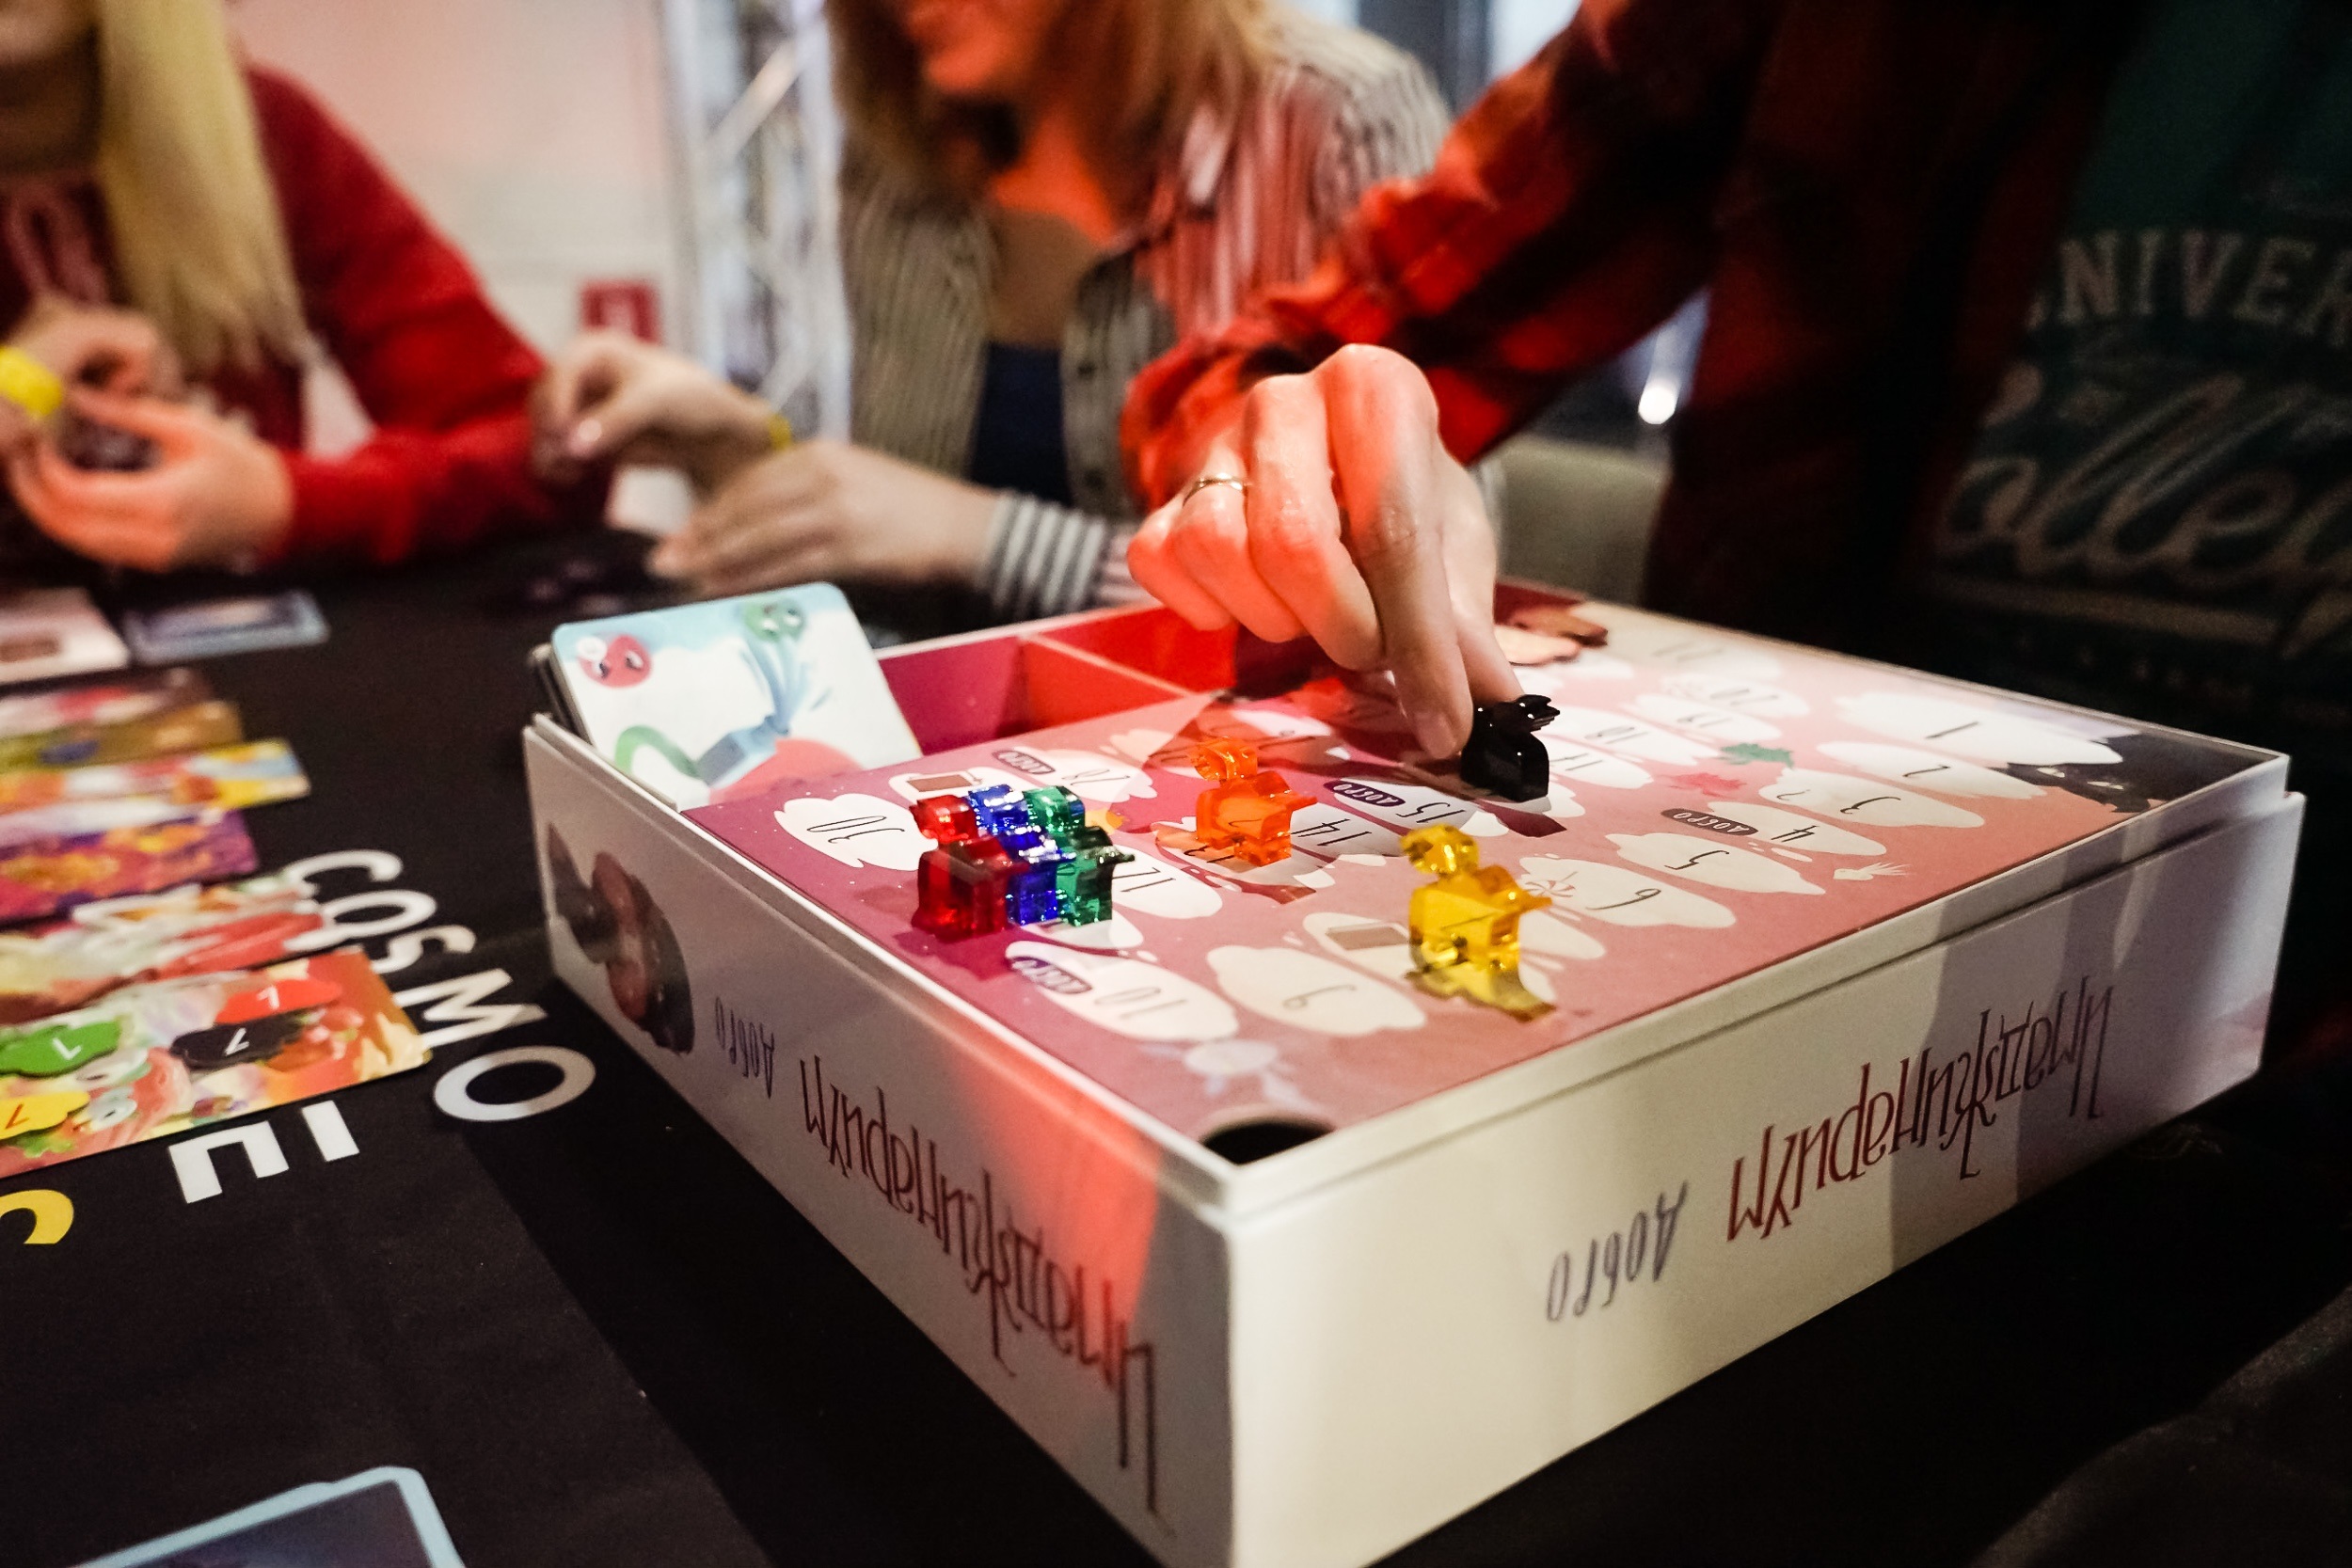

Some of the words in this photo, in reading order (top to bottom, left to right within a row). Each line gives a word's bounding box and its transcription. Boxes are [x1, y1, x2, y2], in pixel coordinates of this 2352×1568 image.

[1395, 801, 1467, 824] 15
[1839, 796, 1901, 815] 3
[806, 815, 906, 845] 30
[1291, 818, 1372, 847] 14
[1673, 811, 1748, 834] ДОБРО
[1771, 824, 1820, 844] 4
[1664, 849, 1730, 871] 5
[1585, 888, 1662, 911] 6
[284, 849, 596, 1122] COSMO
